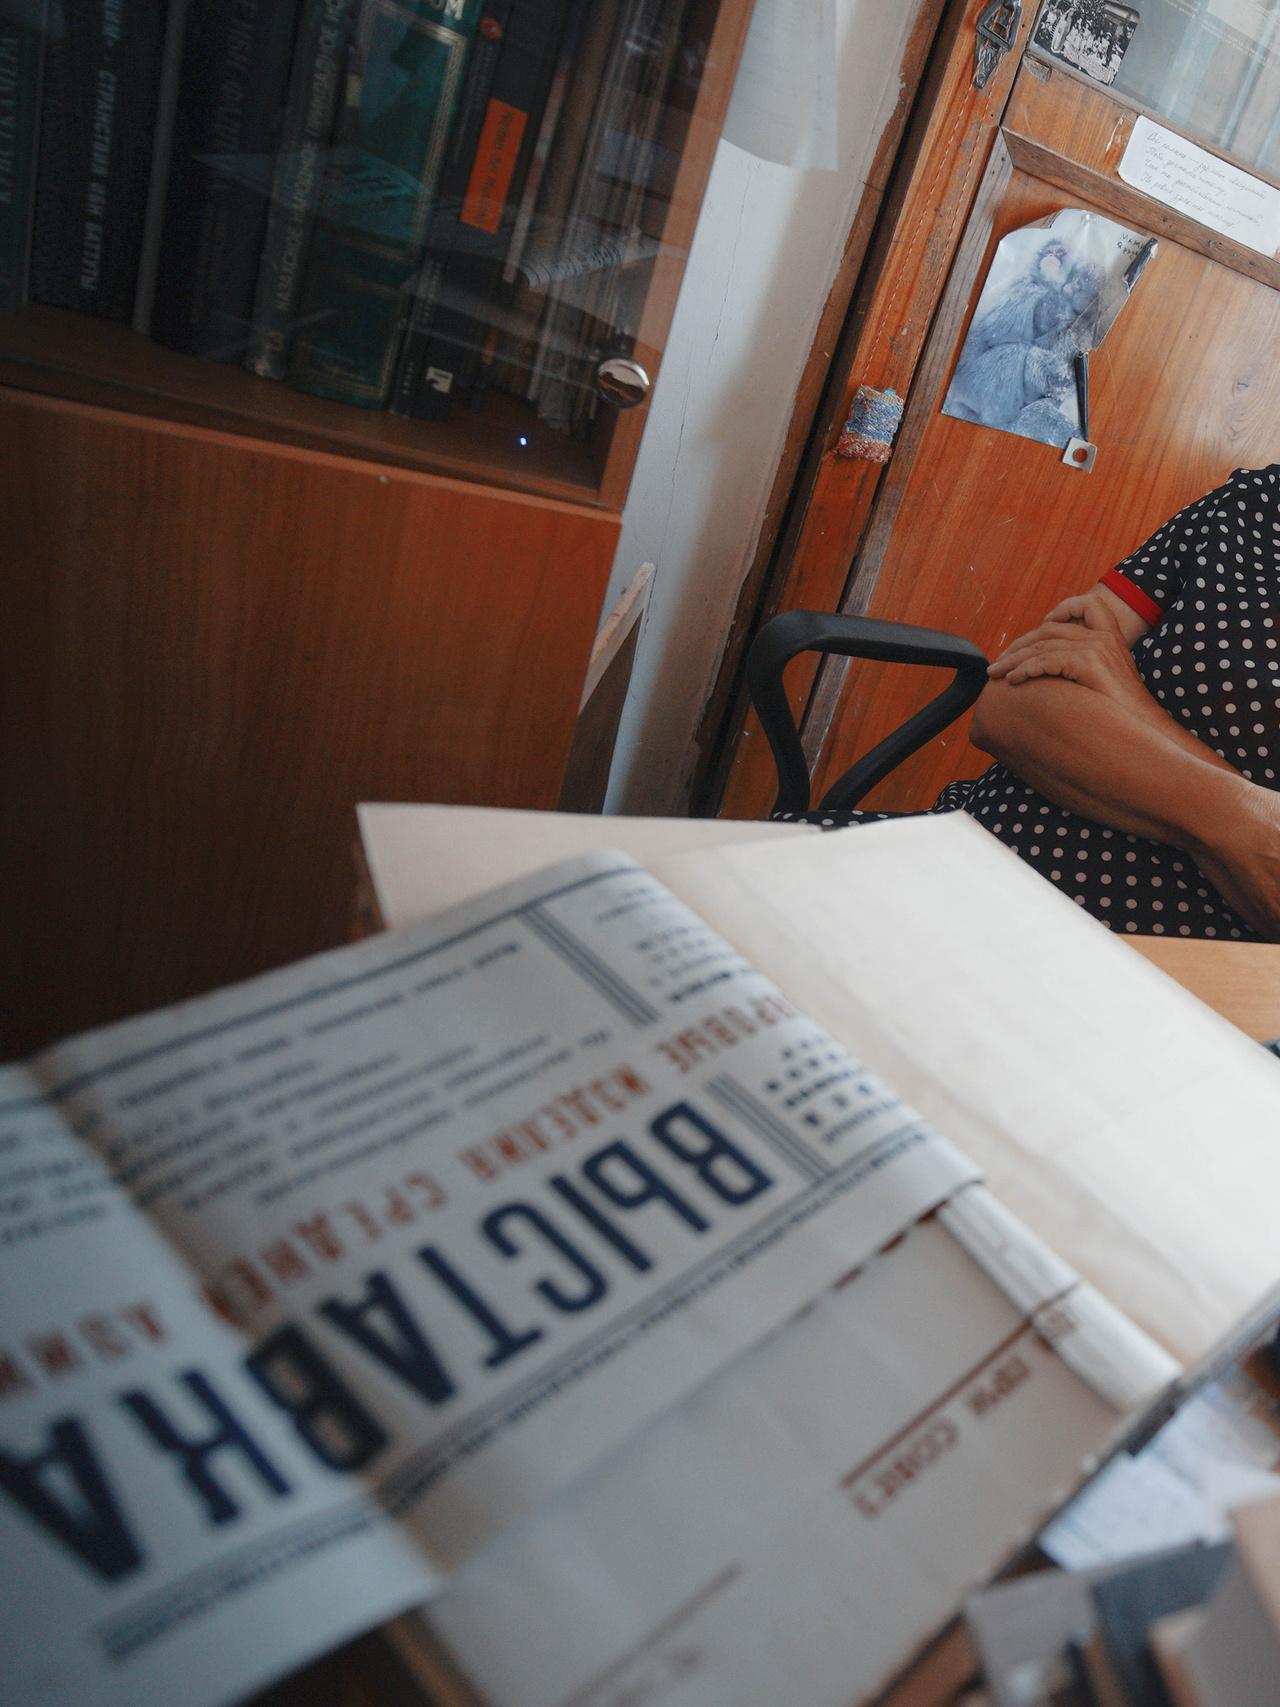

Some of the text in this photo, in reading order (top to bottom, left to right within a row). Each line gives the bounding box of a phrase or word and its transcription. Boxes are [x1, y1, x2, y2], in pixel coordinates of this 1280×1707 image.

[90, 69, 118, 175] СТРАНСТВИЯ
[87, 181, 104, 216] ИБН
[273, 222, 303, 312] КАЗАХСКОЕ
[289, 139, 319, 222] НАРОДНОЕ
[80, 221, 102, 291] БАТТУТЫ
[458, 1062, 654, 1181] ИЗДЕЛИЯ
[0, 1100, 775, 1586] ВЫСТАВКА
